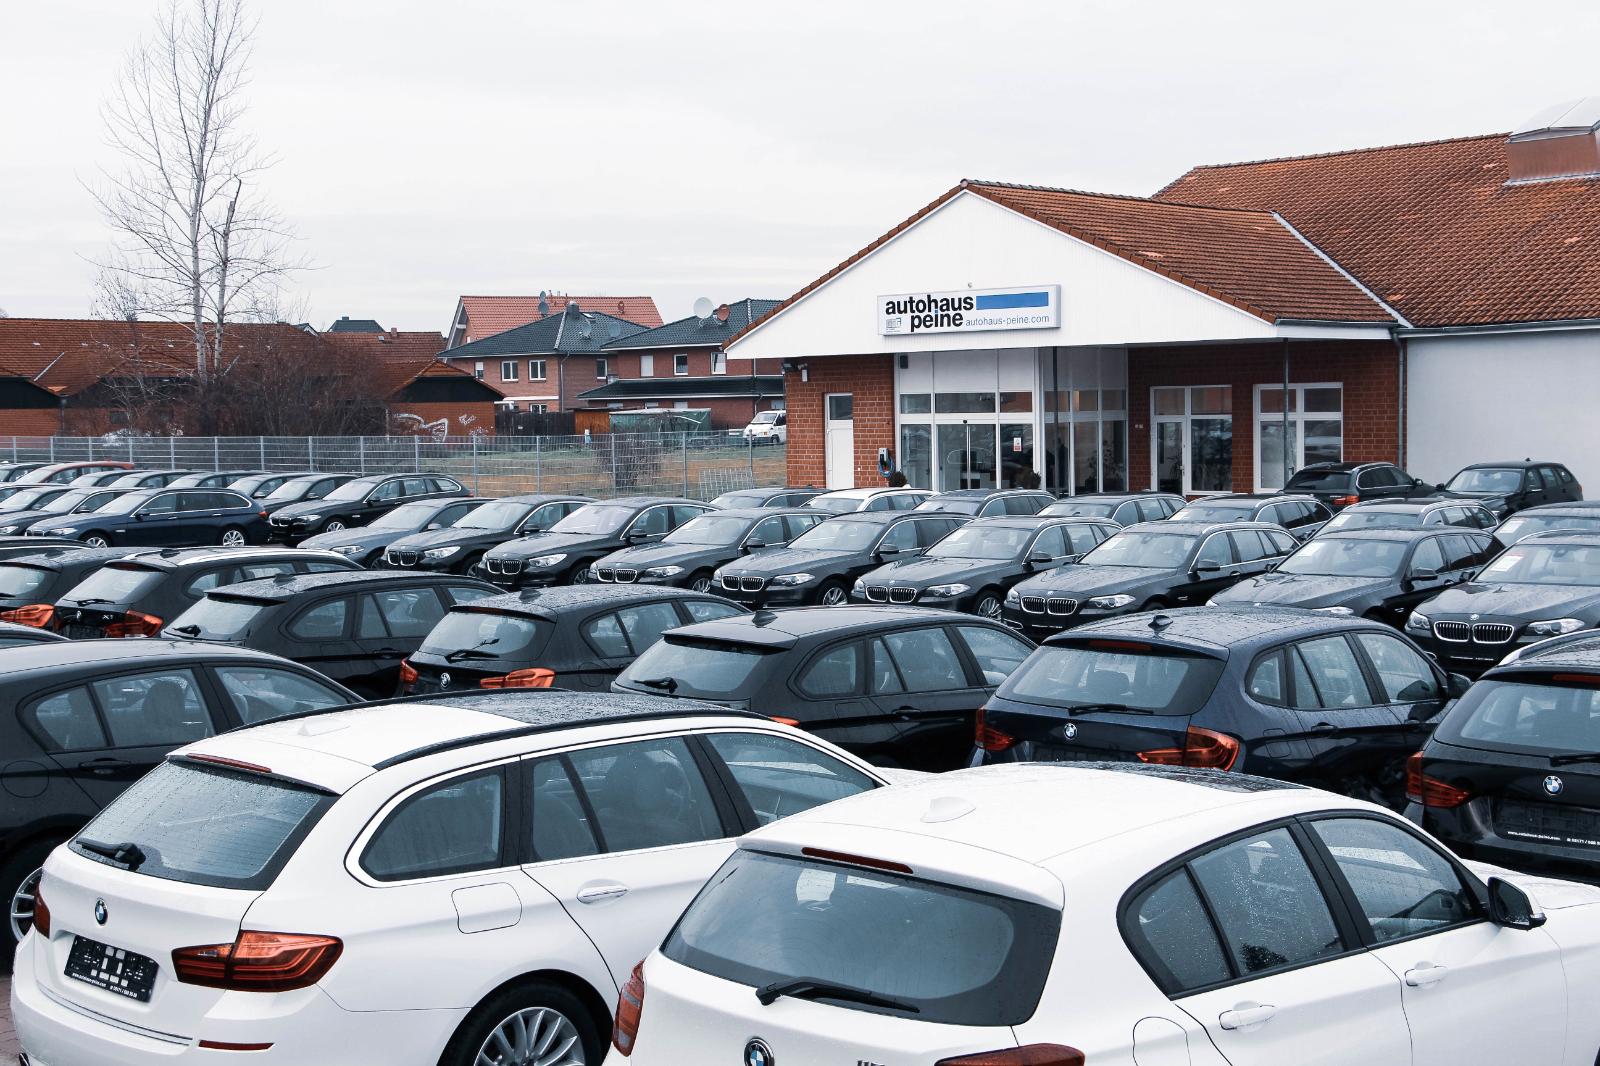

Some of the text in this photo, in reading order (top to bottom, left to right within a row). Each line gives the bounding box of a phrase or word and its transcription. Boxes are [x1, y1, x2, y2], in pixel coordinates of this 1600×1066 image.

[885, 294, 974, 315] autohaus
[910, 309, 964, 333] peine
[965, 315, 1050, 327] autohaus-peine.com
